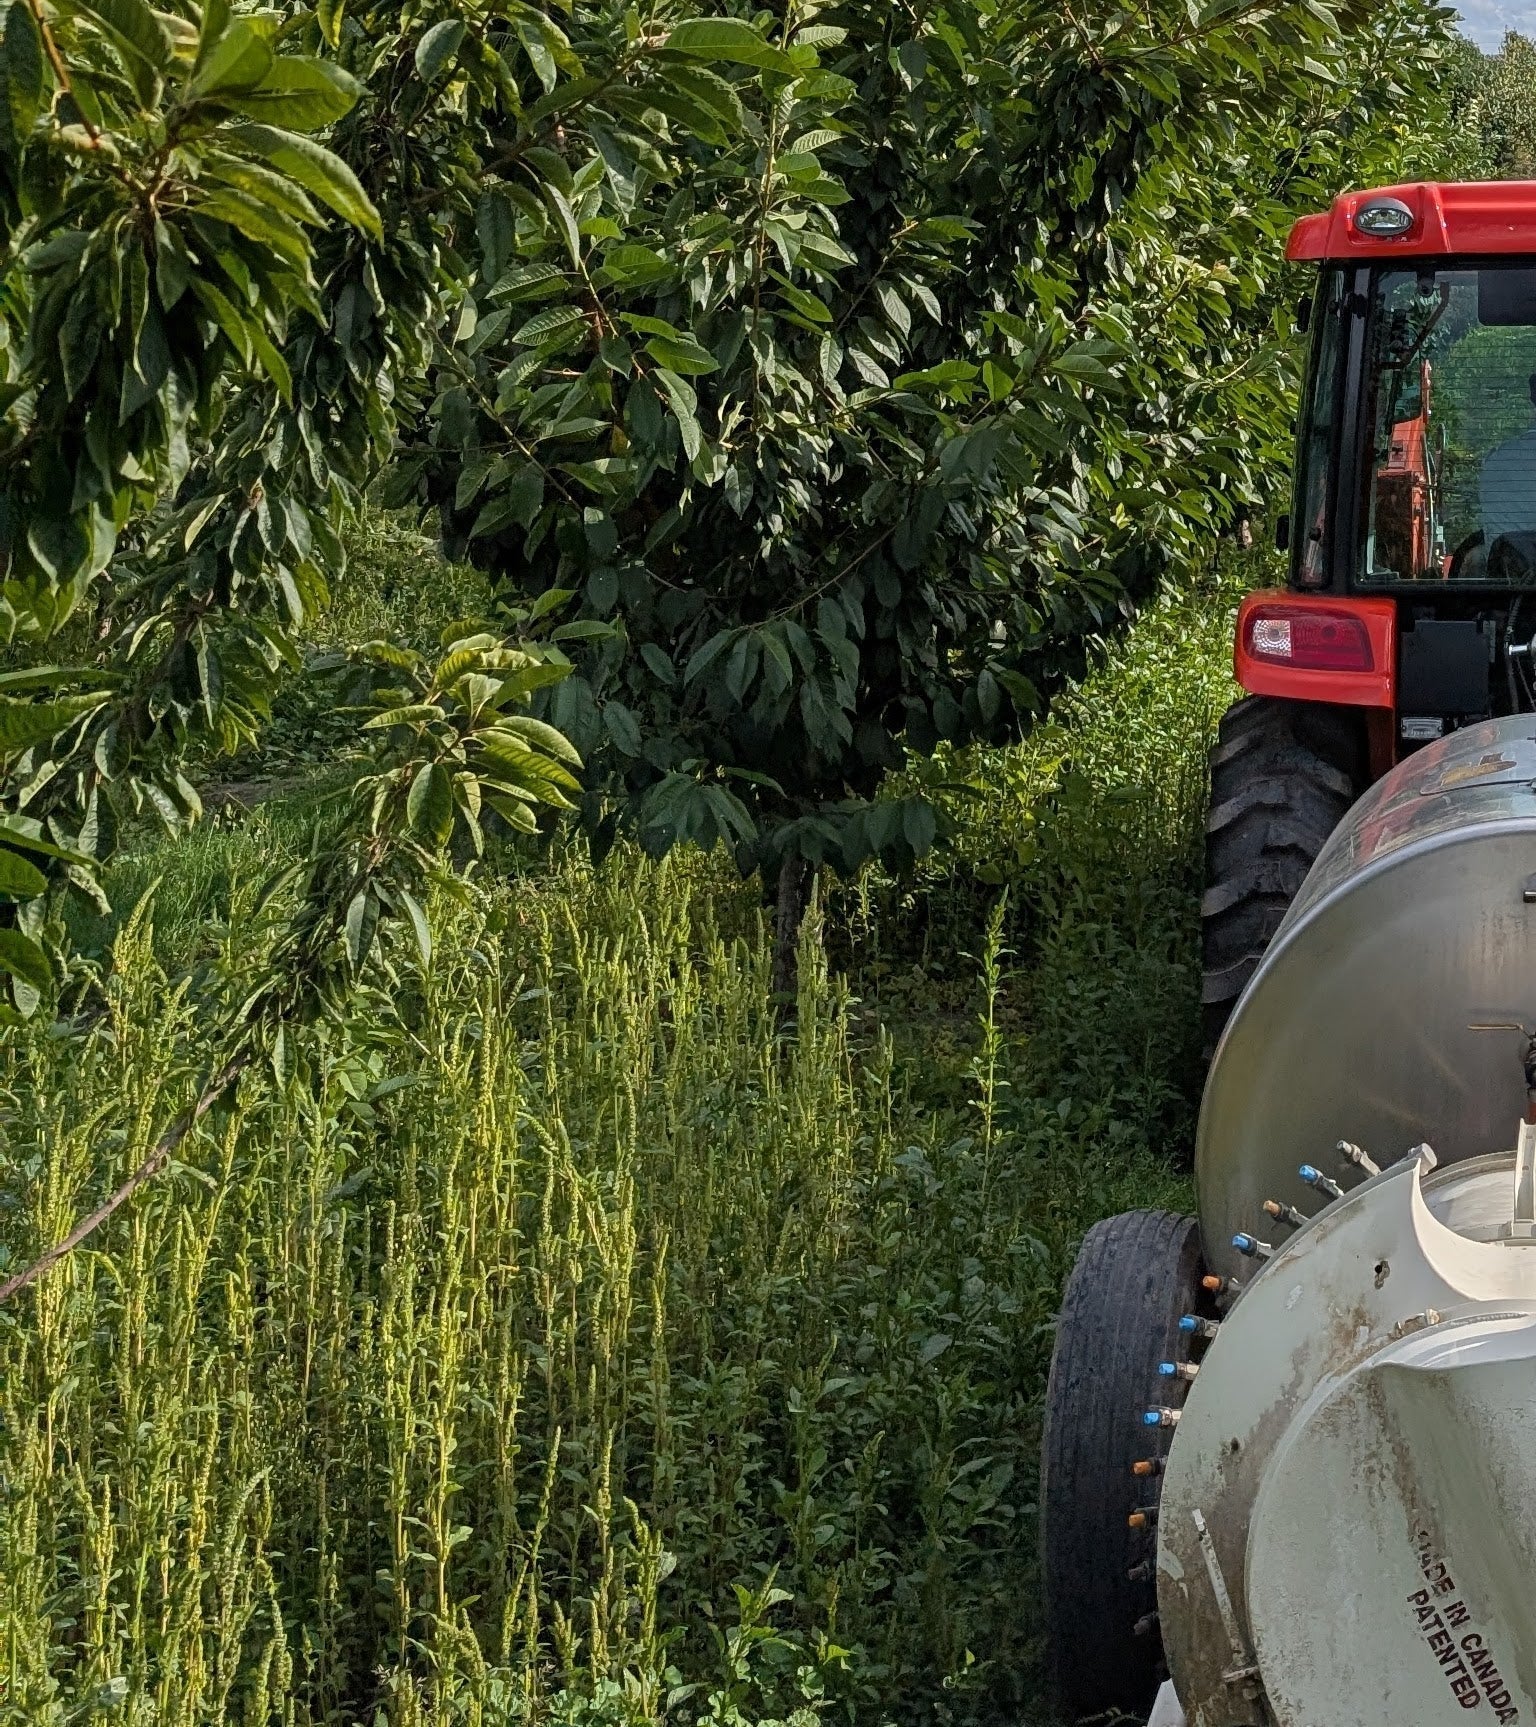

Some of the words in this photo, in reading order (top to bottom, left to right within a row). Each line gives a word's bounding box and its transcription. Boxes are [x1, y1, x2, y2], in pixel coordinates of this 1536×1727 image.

[1406, 1588, 1481, 1709] PATENTED
[1443, 1600, 1471, 1628] IN
[1461, 1633, 1518, 1725] CANADA
